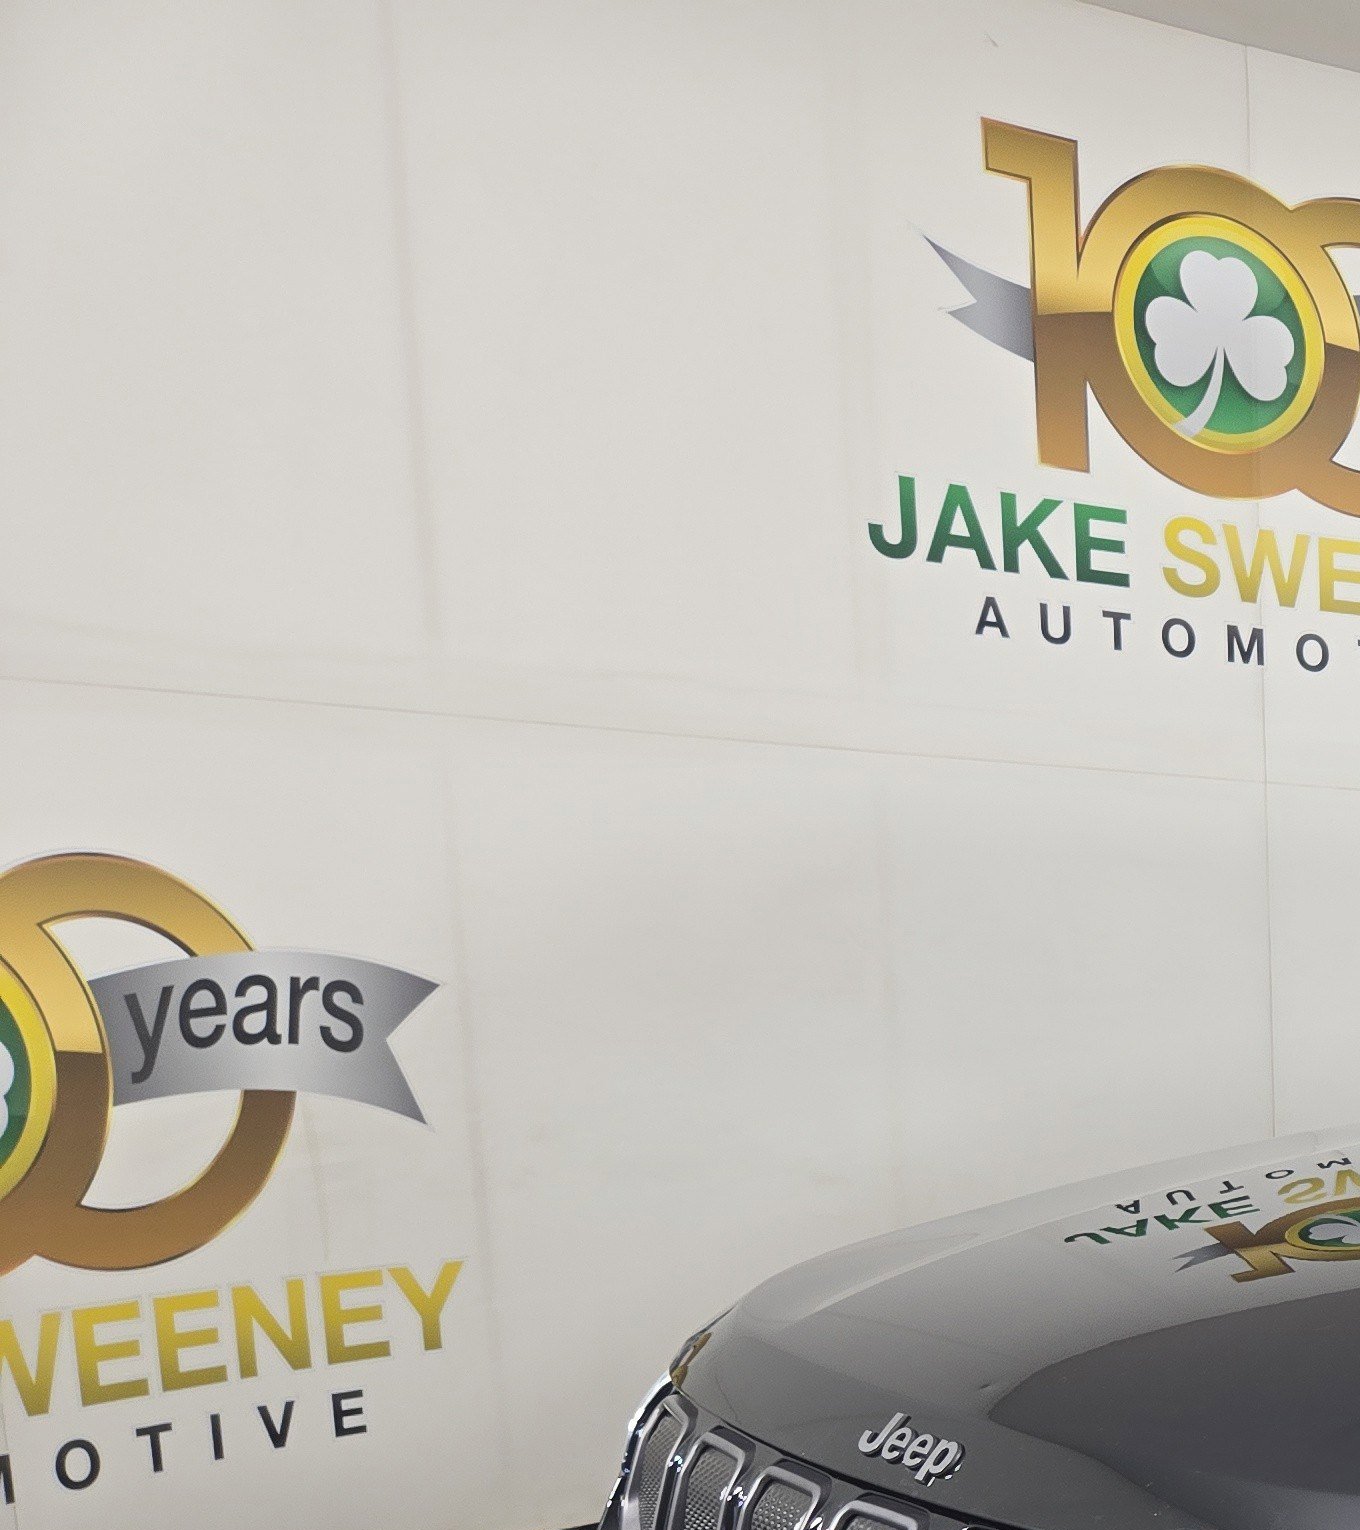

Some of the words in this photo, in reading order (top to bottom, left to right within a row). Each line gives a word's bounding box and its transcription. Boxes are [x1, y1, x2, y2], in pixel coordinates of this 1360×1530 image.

[867, 472, 1132, 590] JAKE
[123, 972, 366, 1085] years
[858, 1411, 964, 1485] Jeep
